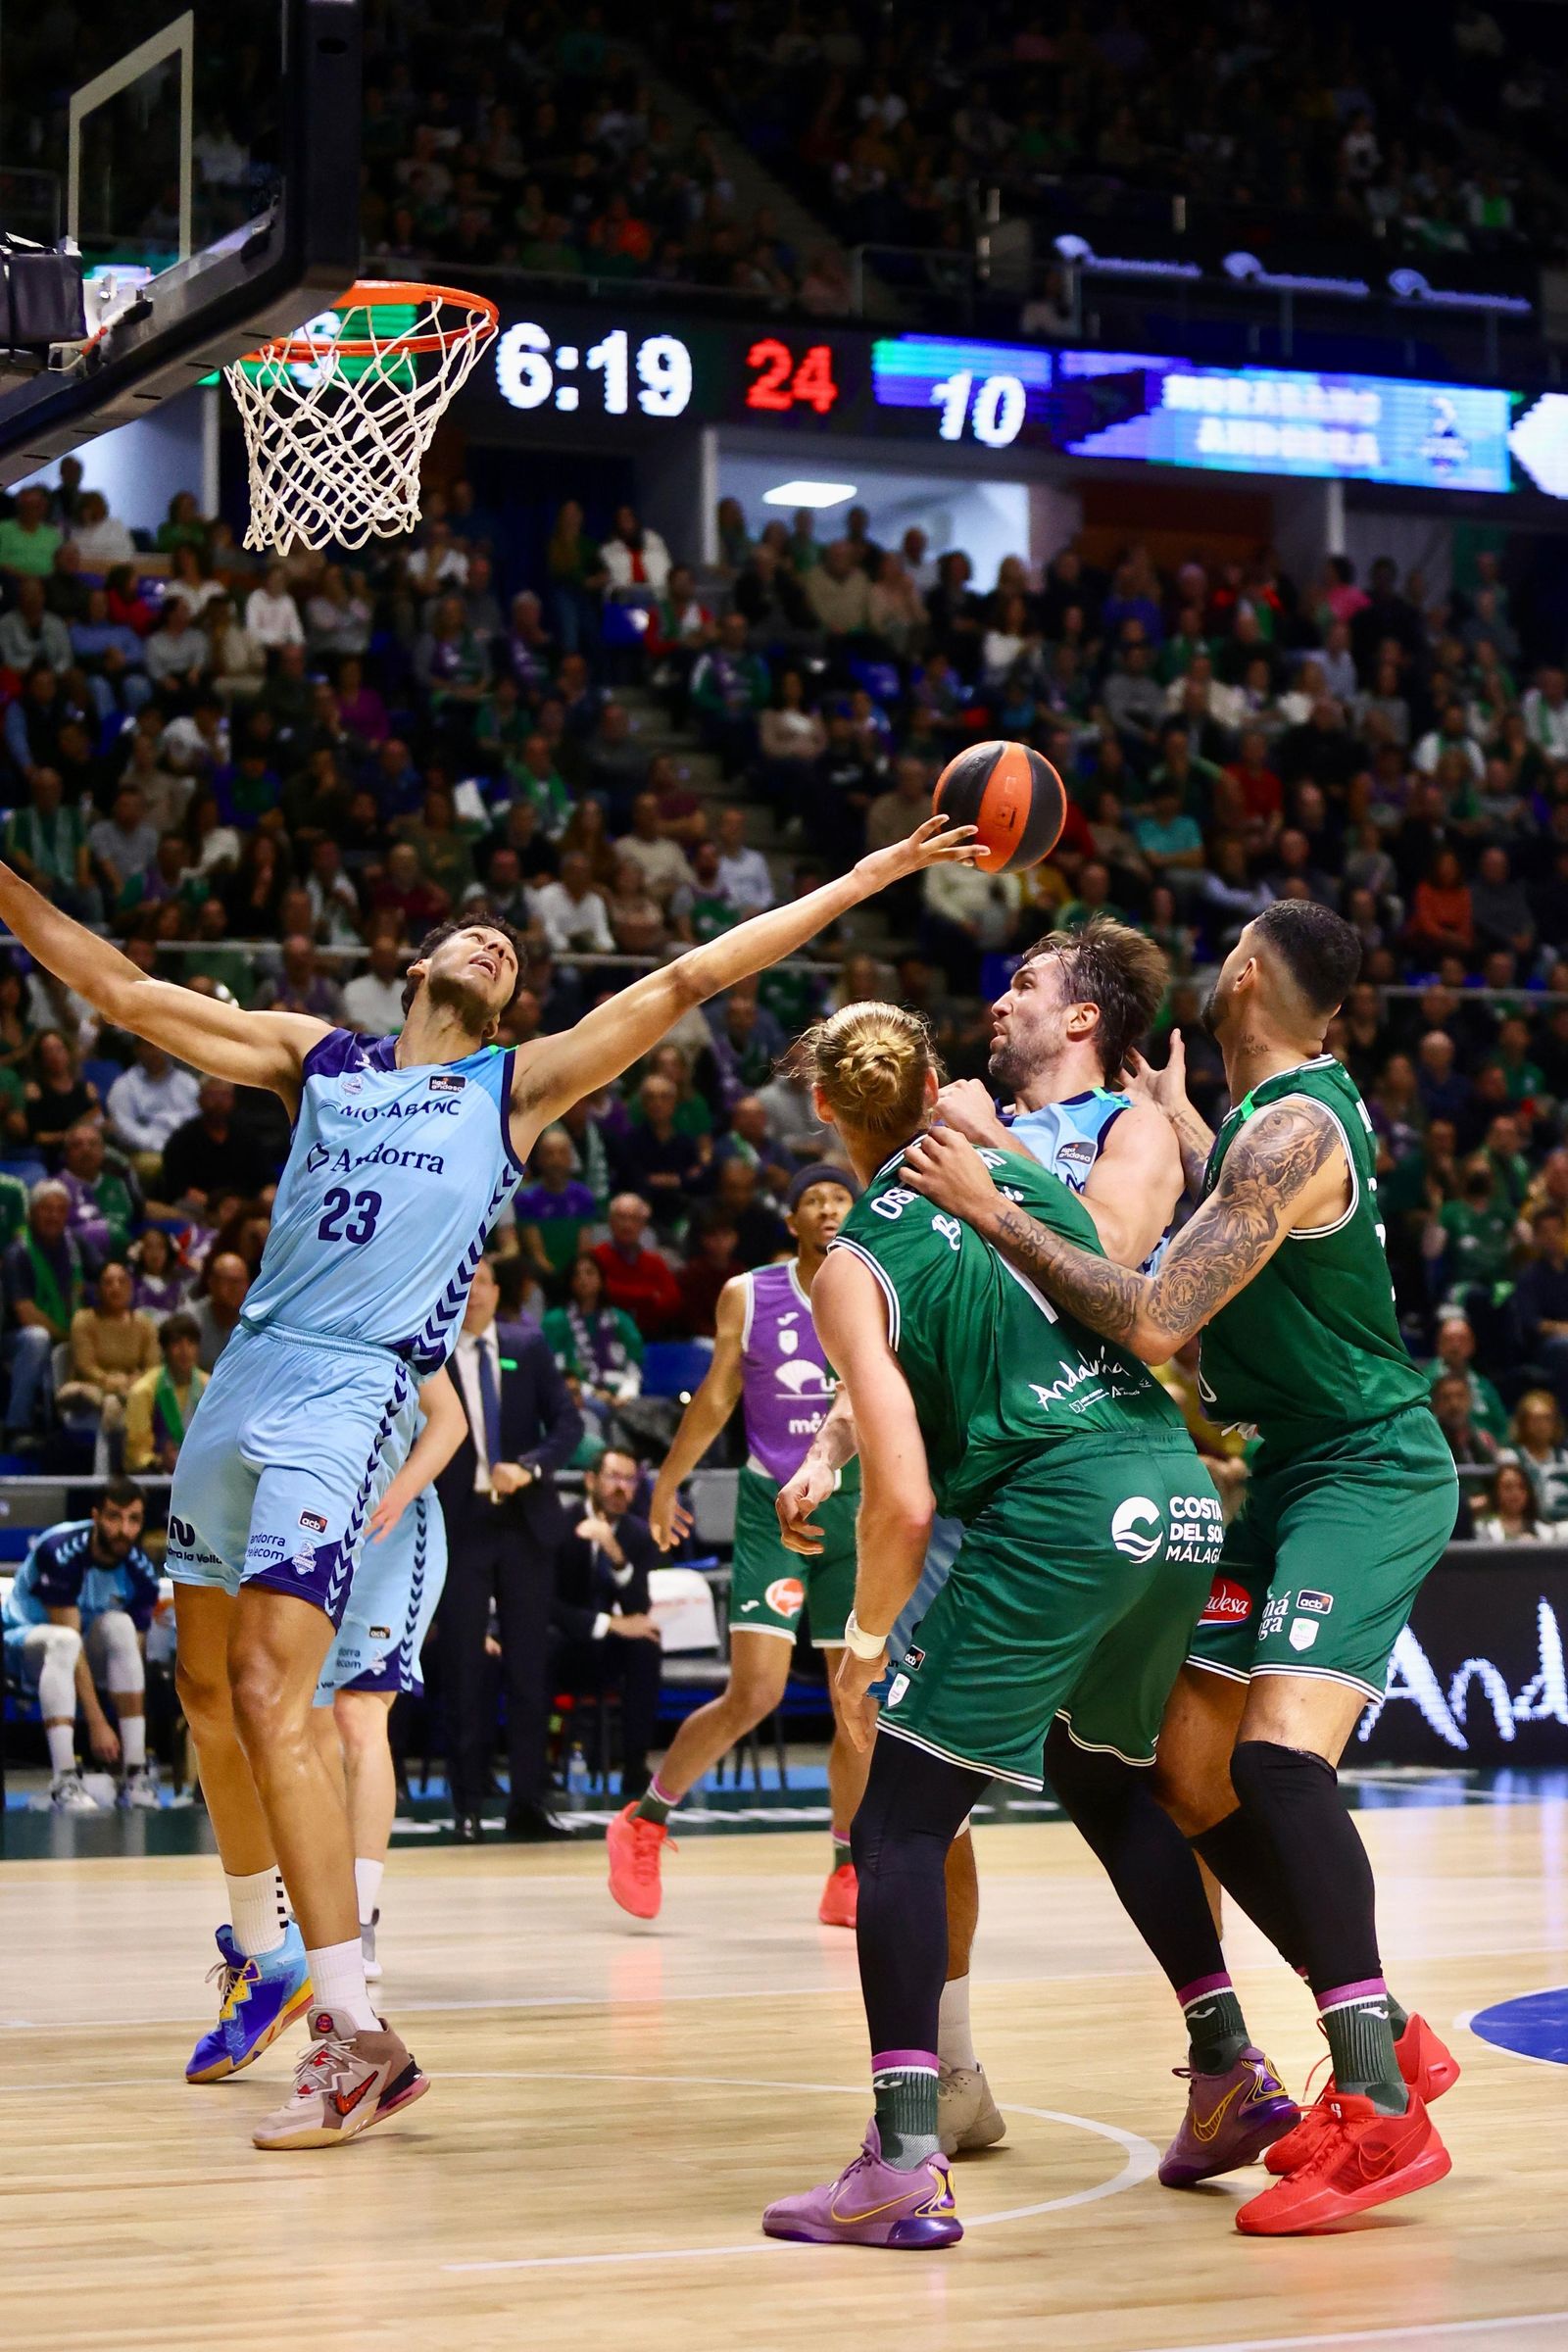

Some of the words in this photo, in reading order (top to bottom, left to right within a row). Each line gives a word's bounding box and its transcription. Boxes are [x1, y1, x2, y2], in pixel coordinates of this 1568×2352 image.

[496, 322, 692, 416] 6:19
[745, 338, 838, 414] 24
[931, 368, 1027, 448] 10
[340, 1099, 462, 1123] MOABANC
[318, 1187, 382, 1245] 23
[1169, 1496, 1223, 1521] COSTA
[301, 1516, 321, 1530] acb
[1169, 1523, 1205, 1542] DEL
[183, 1551, 195, 1561] la
[1299, 1597, 1323, 1610] acb
